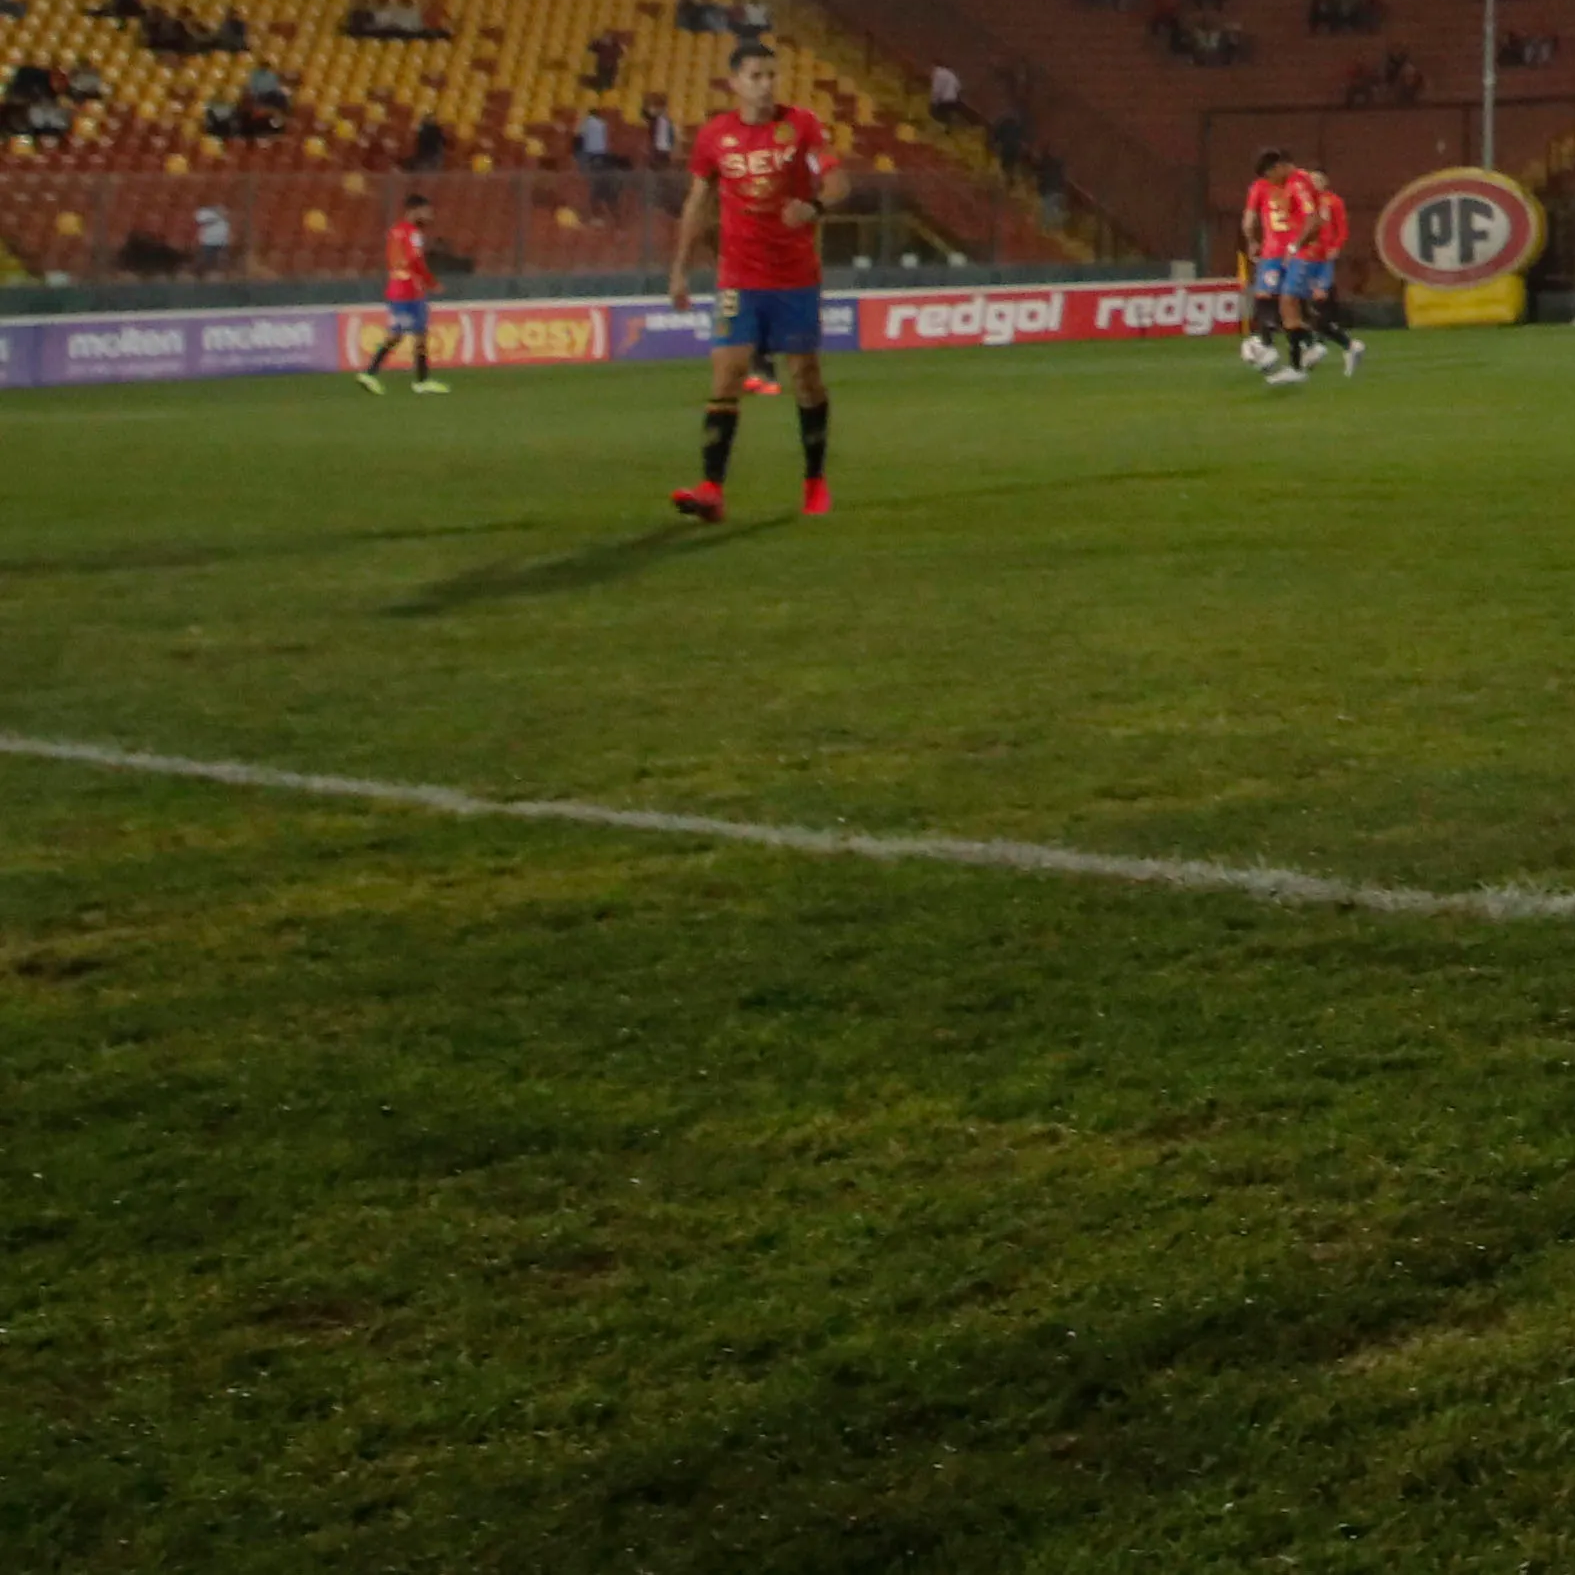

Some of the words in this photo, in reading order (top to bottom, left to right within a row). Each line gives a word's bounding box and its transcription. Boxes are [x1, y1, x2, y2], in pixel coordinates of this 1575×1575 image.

[1416, 196, 1494, 265] PF
[884, 291, 1067, 346] redgol
[1095, 287, 1241, 336] redgo
